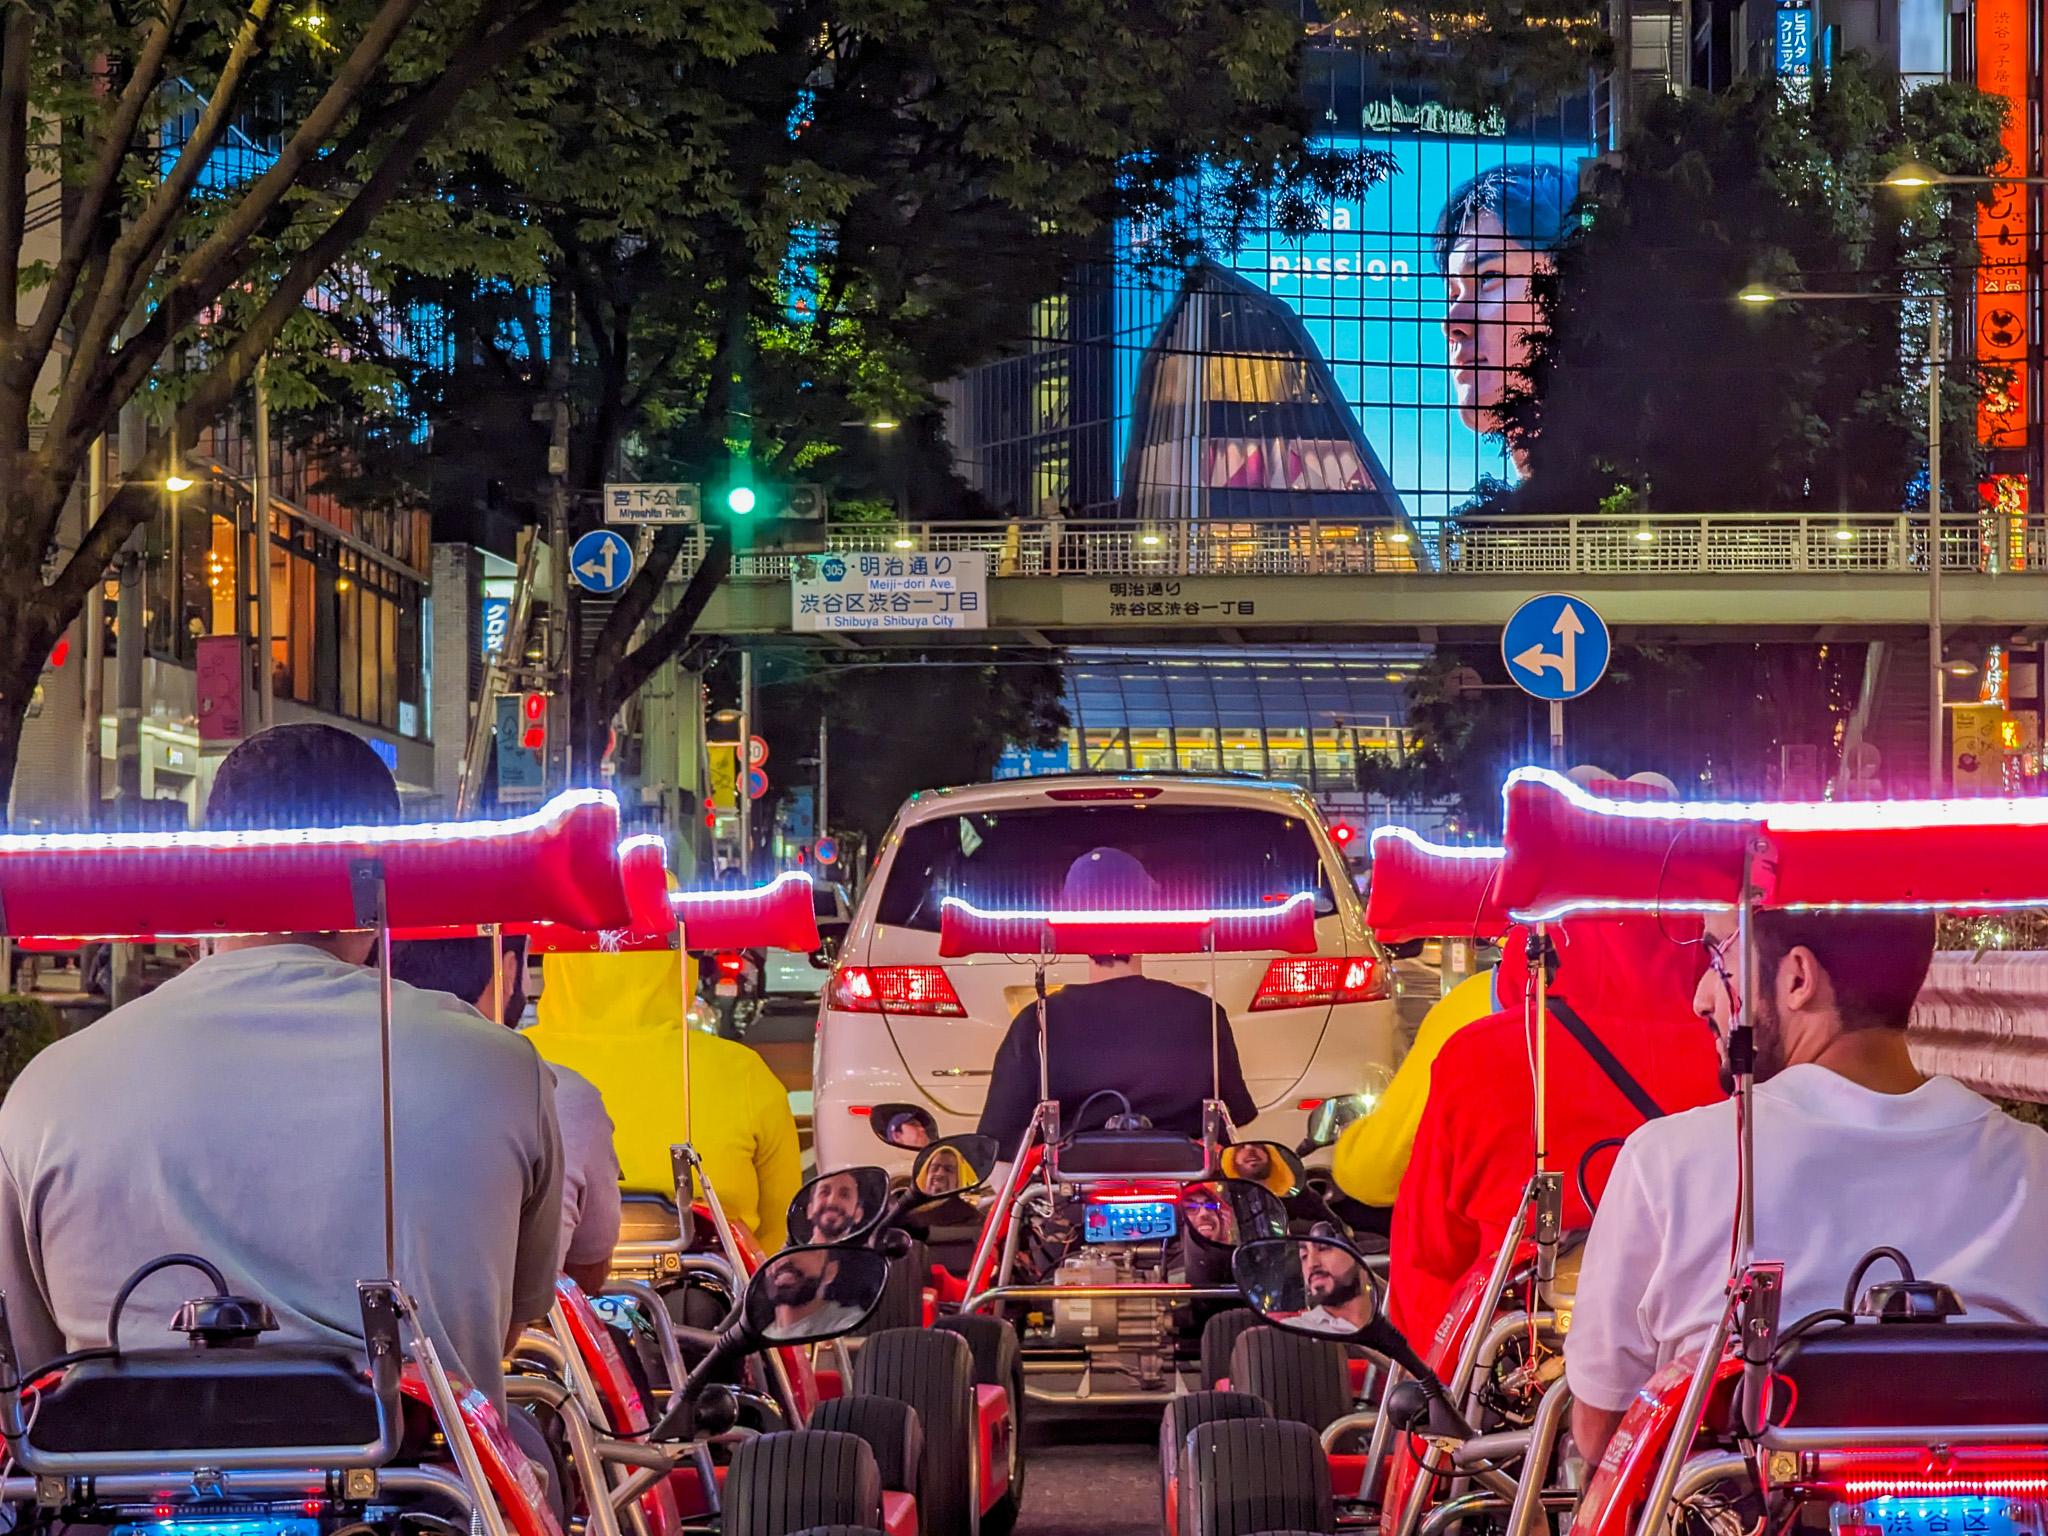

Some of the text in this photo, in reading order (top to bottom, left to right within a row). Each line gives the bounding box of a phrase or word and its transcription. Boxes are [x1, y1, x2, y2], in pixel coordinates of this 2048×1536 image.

[1794, 12, 1807, 59] ヒラハタ
[1780, 20, 1793, 73] クリニック
[1270, 252, 1409, 286] passion
[665, 508, 686, 518] Park
[824, 564, 844, 577] 305
[860, 556, 952, 577] 明治通り
[869, 578, 954, 592] Meiji-dori Ave.
[1109, 582, 1181, 597] 明治通り
[800, 592, 978, 614] 渋谷区渋谷一丁目
[1109, 601, 1255, 616] 渋谷区渋谷一丁目
[825, 615, 954, 629] 1 Shibuya Shibuya City
[1887, 1508, 1990, 1533] 渋谷区
